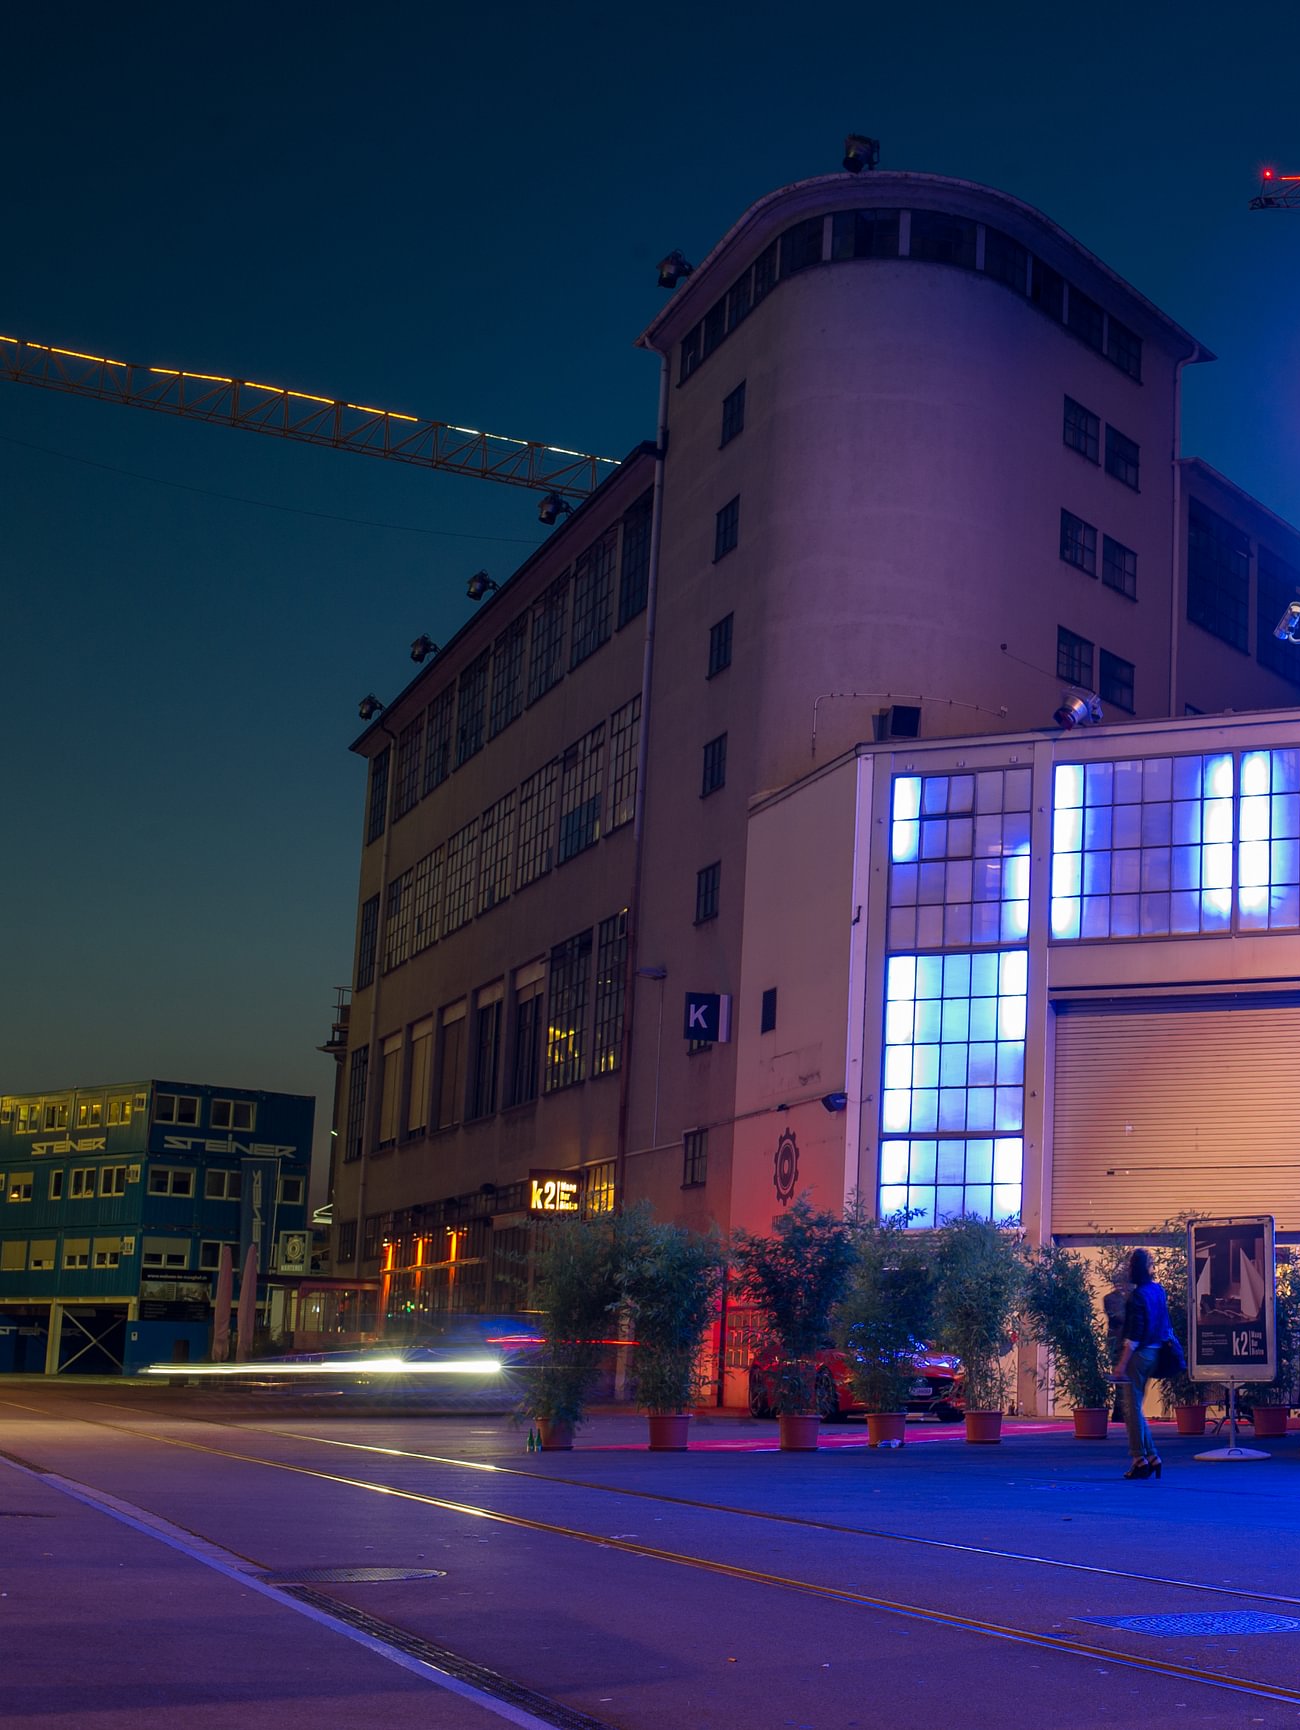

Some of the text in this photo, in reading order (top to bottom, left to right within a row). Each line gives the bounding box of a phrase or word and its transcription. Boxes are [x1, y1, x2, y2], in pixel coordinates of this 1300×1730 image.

[689, 1004, 708, 1028] K
[531, 1180, 555, 1209] k2
[1232, 1331, 1249, 1356] k2
